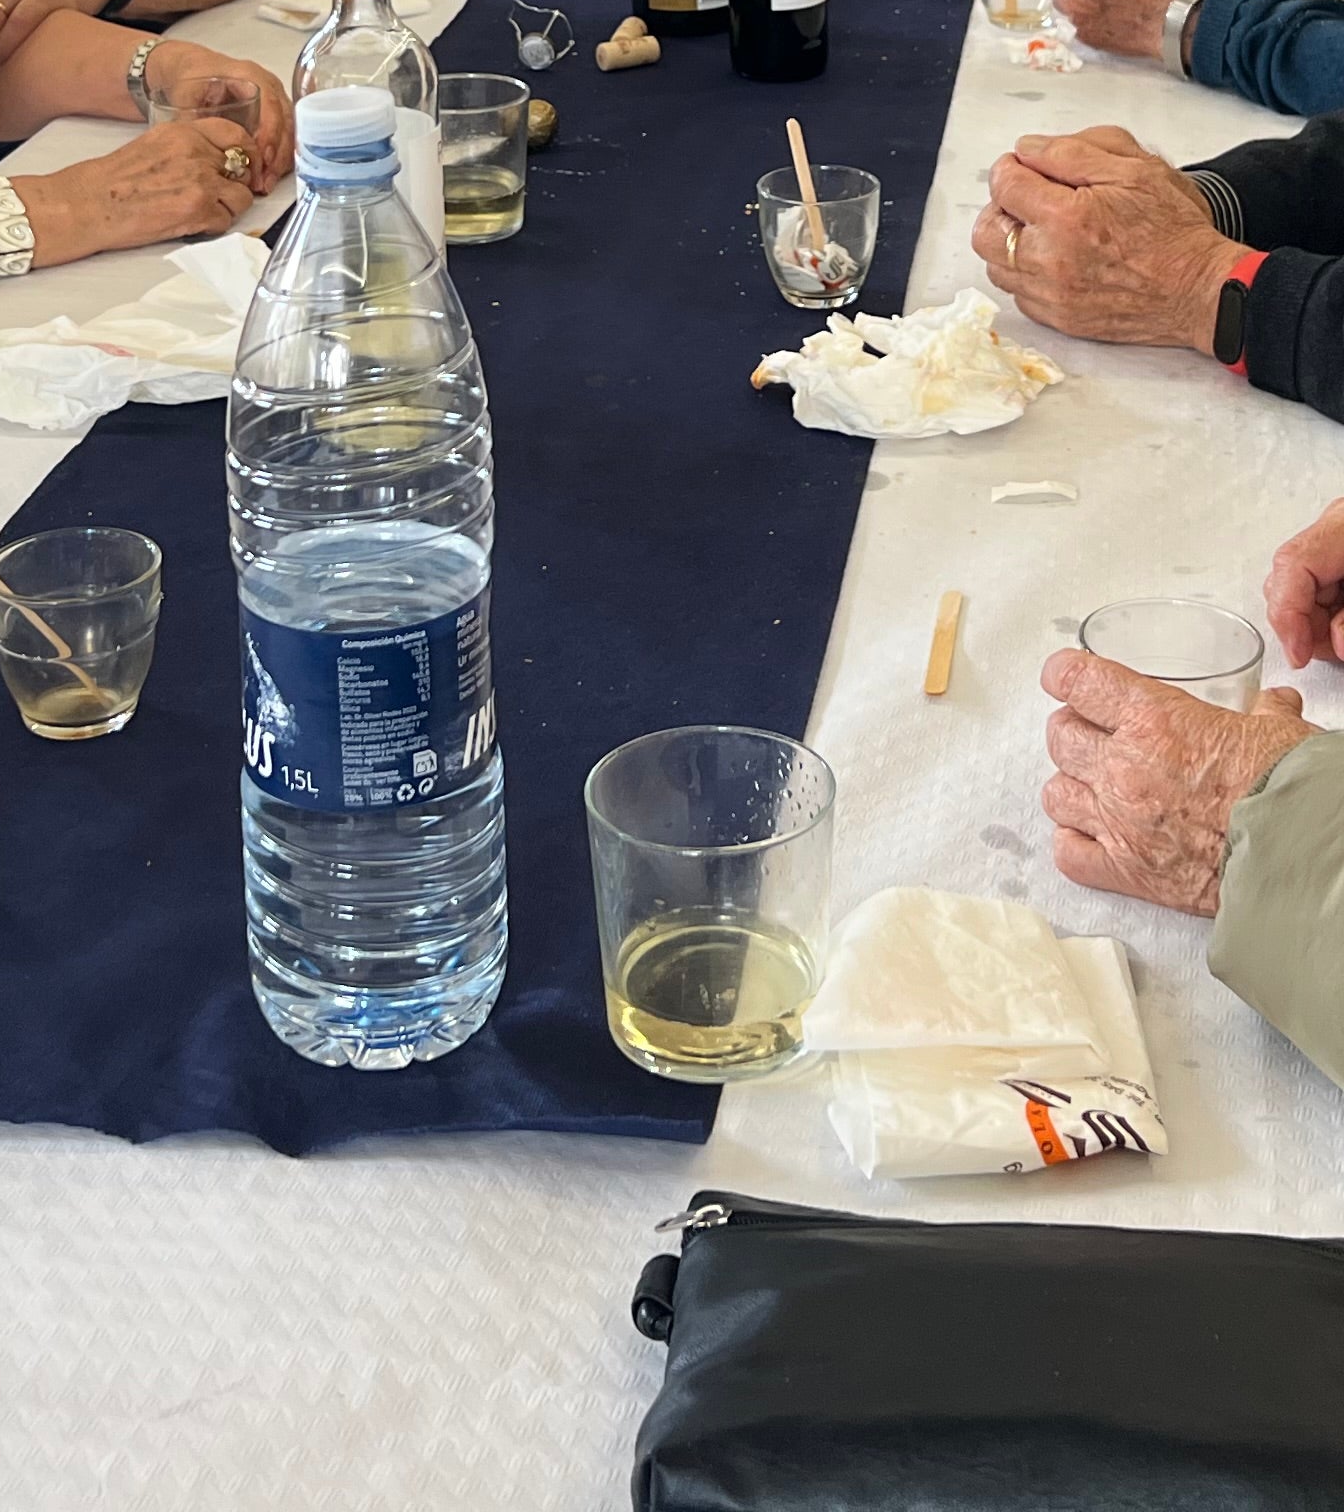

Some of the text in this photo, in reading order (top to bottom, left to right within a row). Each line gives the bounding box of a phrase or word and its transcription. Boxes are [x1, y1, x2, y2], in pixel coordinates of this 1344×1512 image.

[342, 630, 426, 650] Composición Química
[242, 707, 276, 778] US
[281, 765, 320, 793] 1,5L
